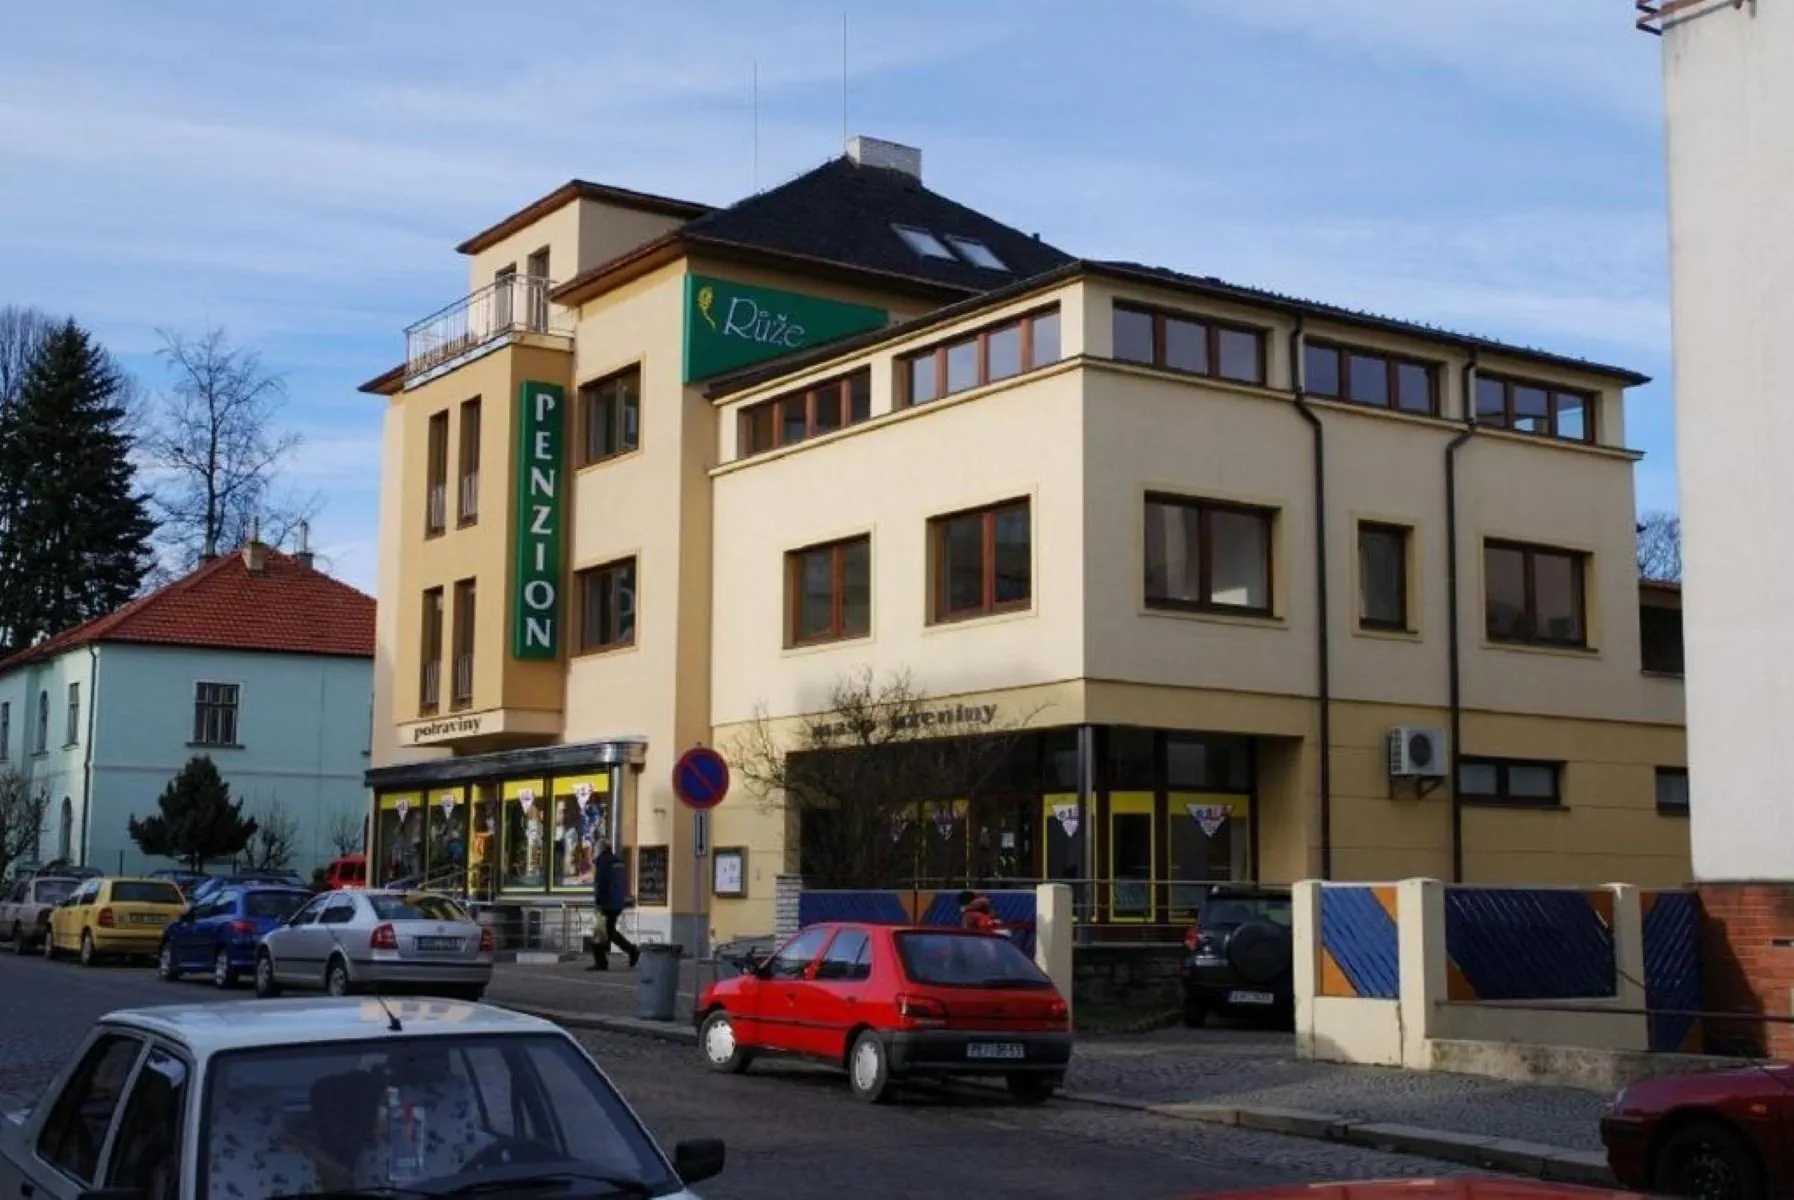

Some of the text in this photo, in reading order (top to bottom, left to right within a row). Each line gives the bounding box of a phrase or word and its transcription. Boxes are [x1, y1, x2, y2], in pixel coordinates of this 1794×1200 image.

[723, 296, 806, 348] Růže
[523, 392, 556, 648] PENZION
[414, 715, 482, 743] potraviny
